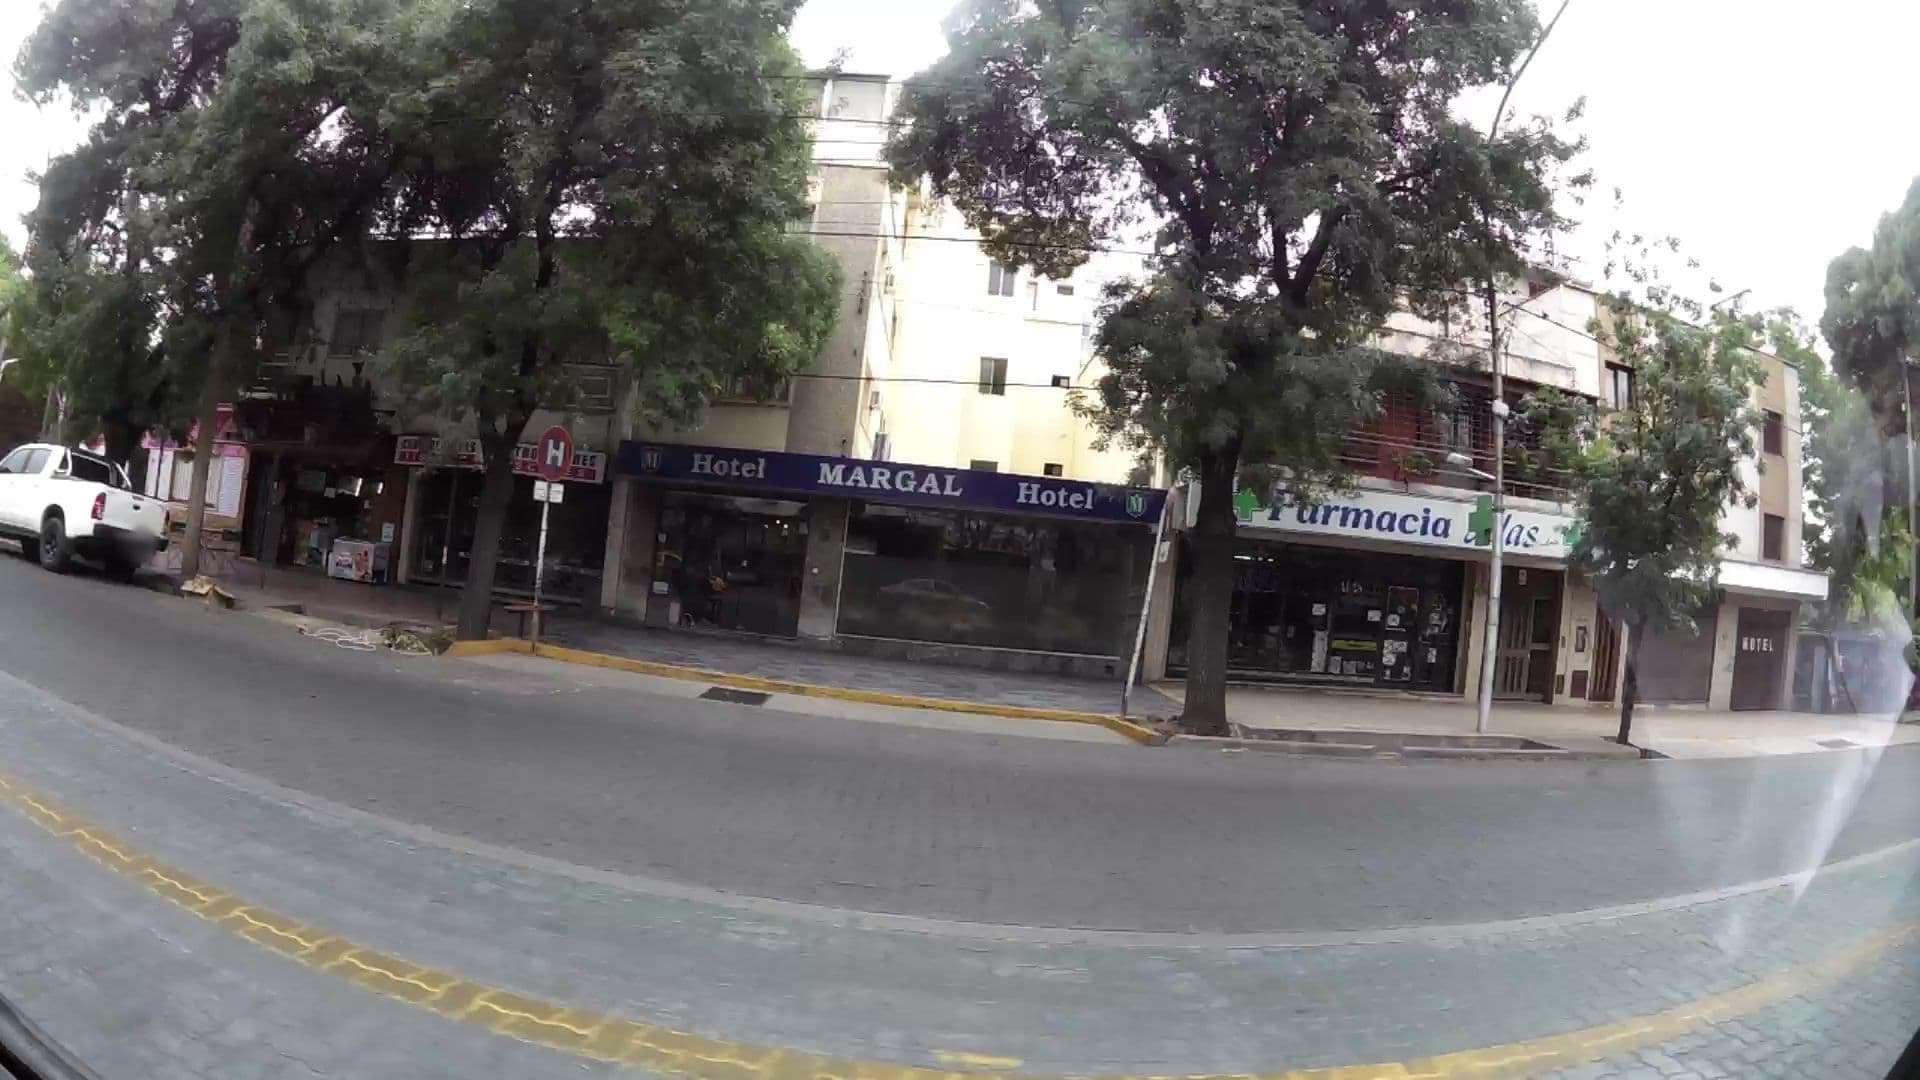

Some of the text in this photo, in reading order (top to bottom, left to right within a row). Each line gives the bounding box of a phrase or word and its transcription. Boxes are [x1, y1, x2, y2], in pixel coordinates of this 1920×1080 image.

[546, 438, 565, 467] H
[691, 453, 1094, 510] Hotel MARGAL Hotel
[1267, 483, 1452, 541] Farmacia
[1742, 636, 1773, 652] HOTEL
